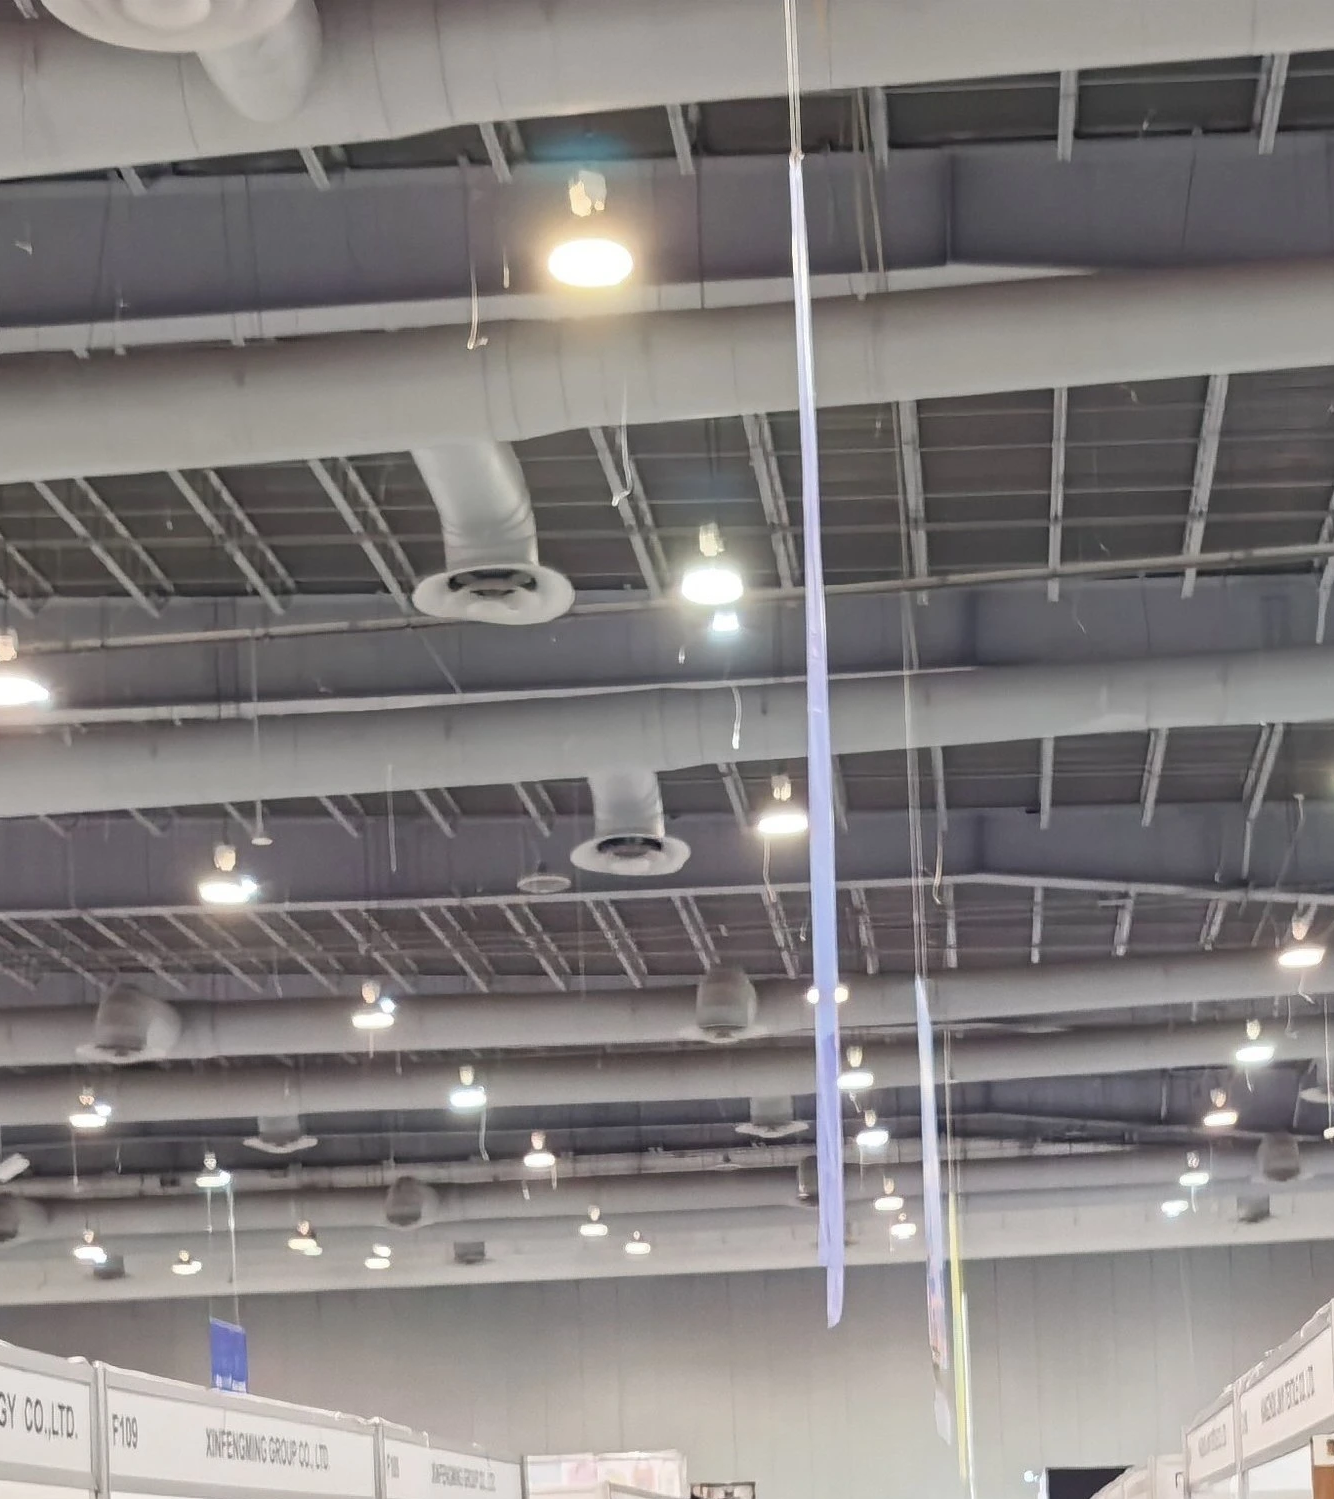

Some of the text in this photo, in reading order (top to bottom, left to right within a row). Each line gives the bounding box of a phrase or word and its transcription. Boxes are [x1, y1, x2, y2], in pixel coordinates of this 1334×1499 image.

[24, 1395, 79, 1441] CO.,LTD.
[112, 1414, 138, 1450] F109
[269, 1436, 297, 1466] GROUP
